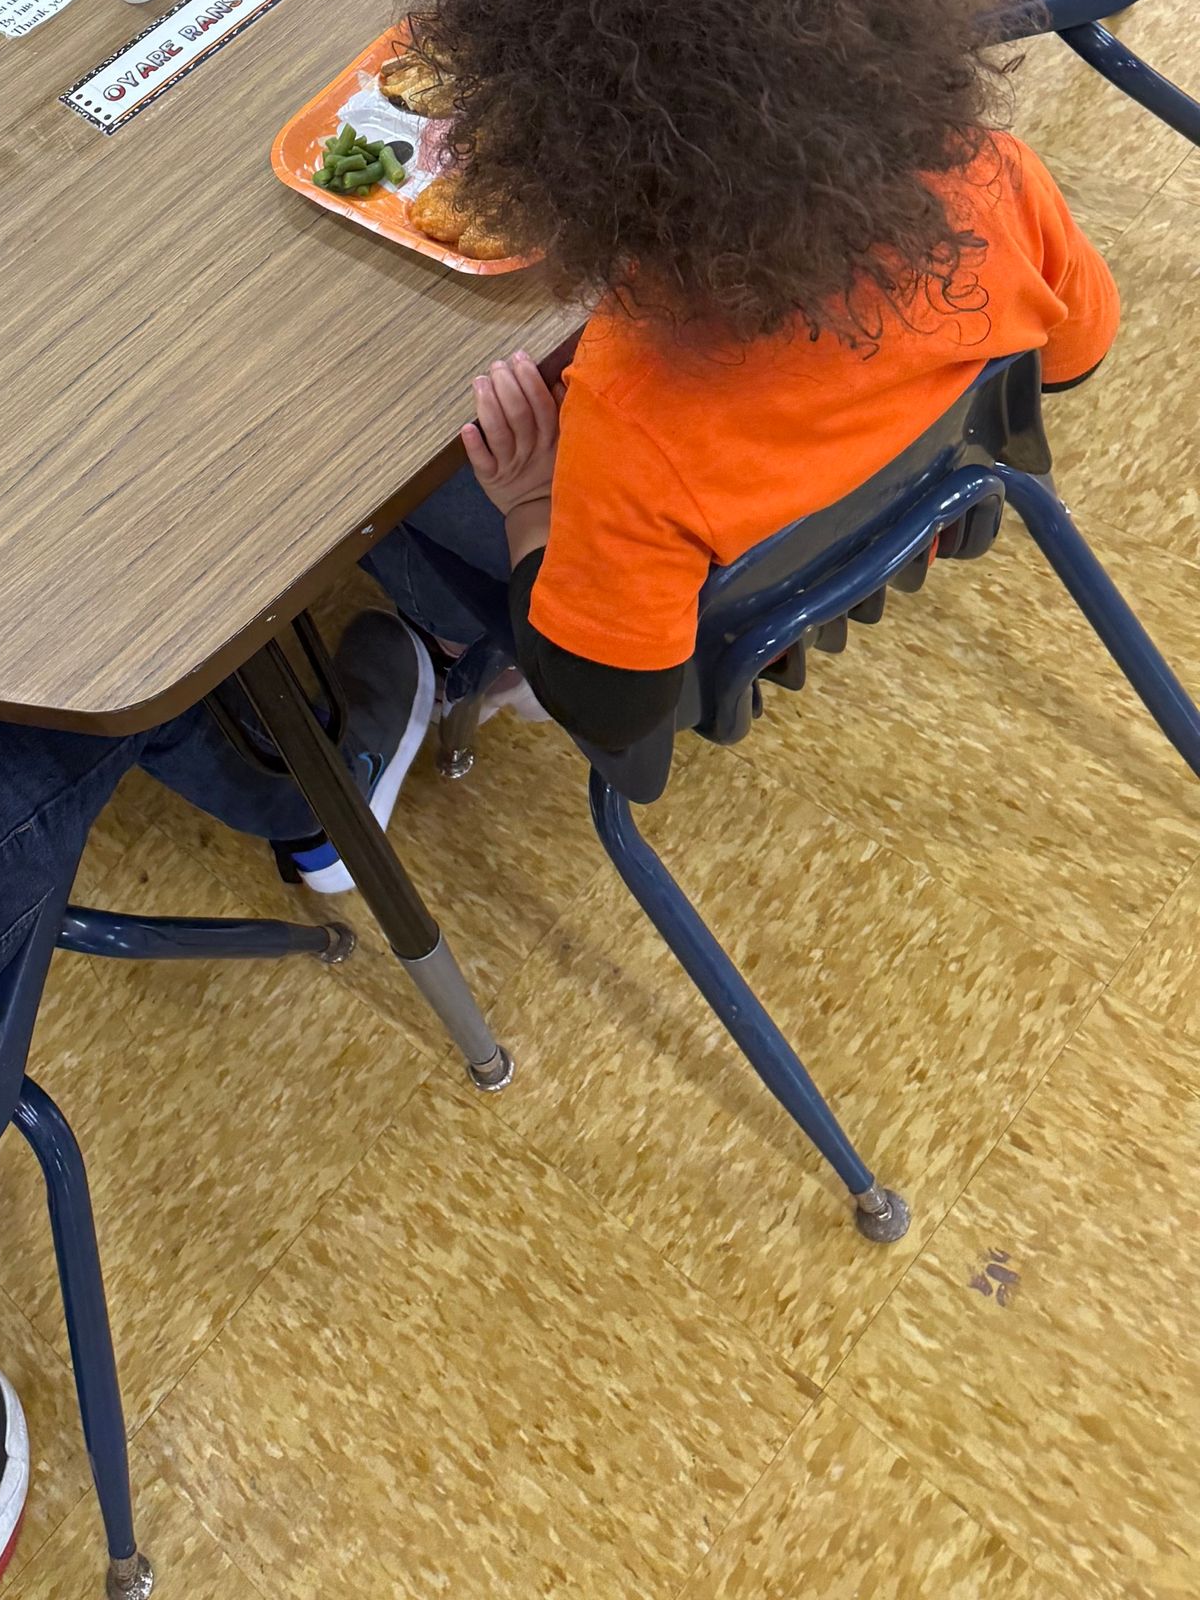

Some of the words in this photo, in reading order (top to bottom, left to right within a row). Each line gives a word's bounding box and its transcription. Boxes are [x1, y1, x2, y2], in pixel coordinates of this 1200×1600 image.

[0, 19, 16, 27] By
[14, 3, 33, 15] his
[11, 10, 49, 40] Thank
[102, 39, 184, 102] OYARE
